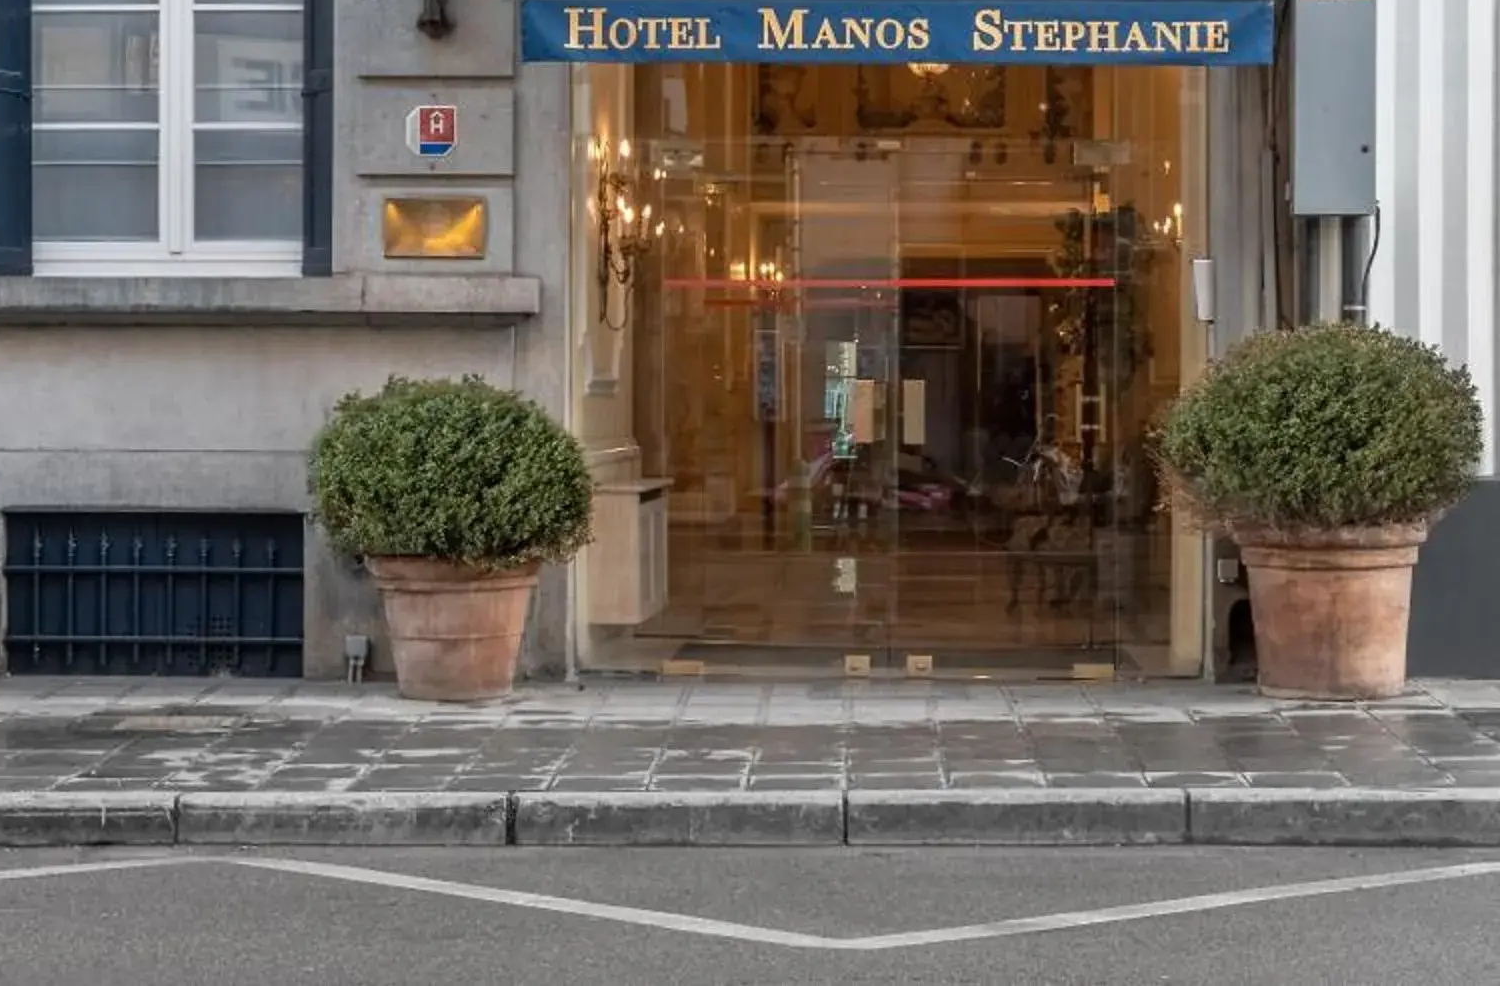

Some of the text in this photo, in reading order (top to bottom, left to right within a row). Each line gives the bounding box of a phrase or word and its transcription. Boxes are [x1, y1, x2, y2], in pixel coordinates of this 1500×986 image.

[563, 7, 1230, 53] HOTEL MANOS STEPHANIE
